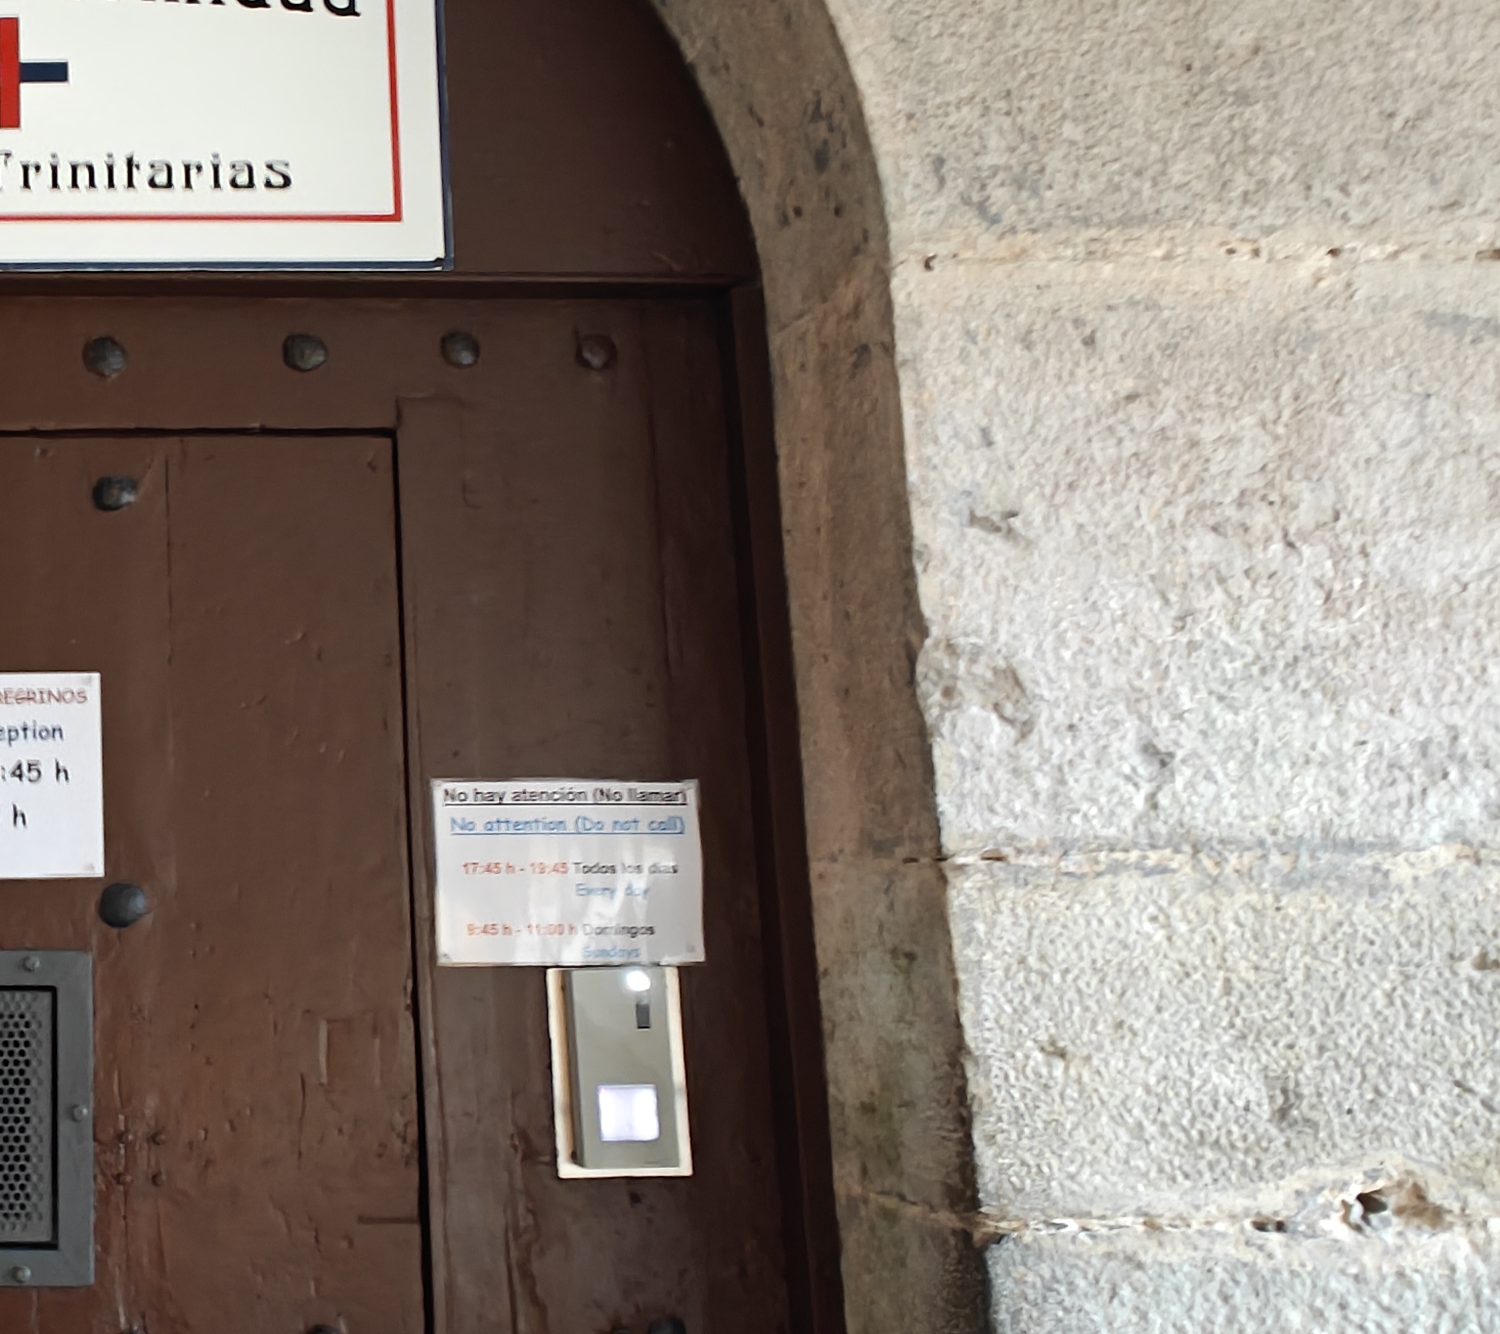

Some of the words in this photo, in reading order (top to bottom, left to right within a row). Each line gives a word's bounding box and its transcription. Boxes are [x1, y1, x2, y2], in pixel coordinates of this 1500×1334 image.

[55, 760, 70, 784] h
[444, 788, 467, 802] No
[474, 788, 506, 805] hay
[511, 786, 588, 802] atención
[593, 788, 623, 803] (No
[13, 805, 27, 829] h
[450, 817, 476, 832] No
[484, 816, 567, 832] attention
[575, 816, 604, 834] (Do
[612, 818, 639, 831] not
[648, 816, 685, 834] call)
[463, 862, 502, 874] 17:45
[572, 862, 616, 874] Todos
[621, 862, 643, 874] los
[582, 923, 655, 938] Domingos
